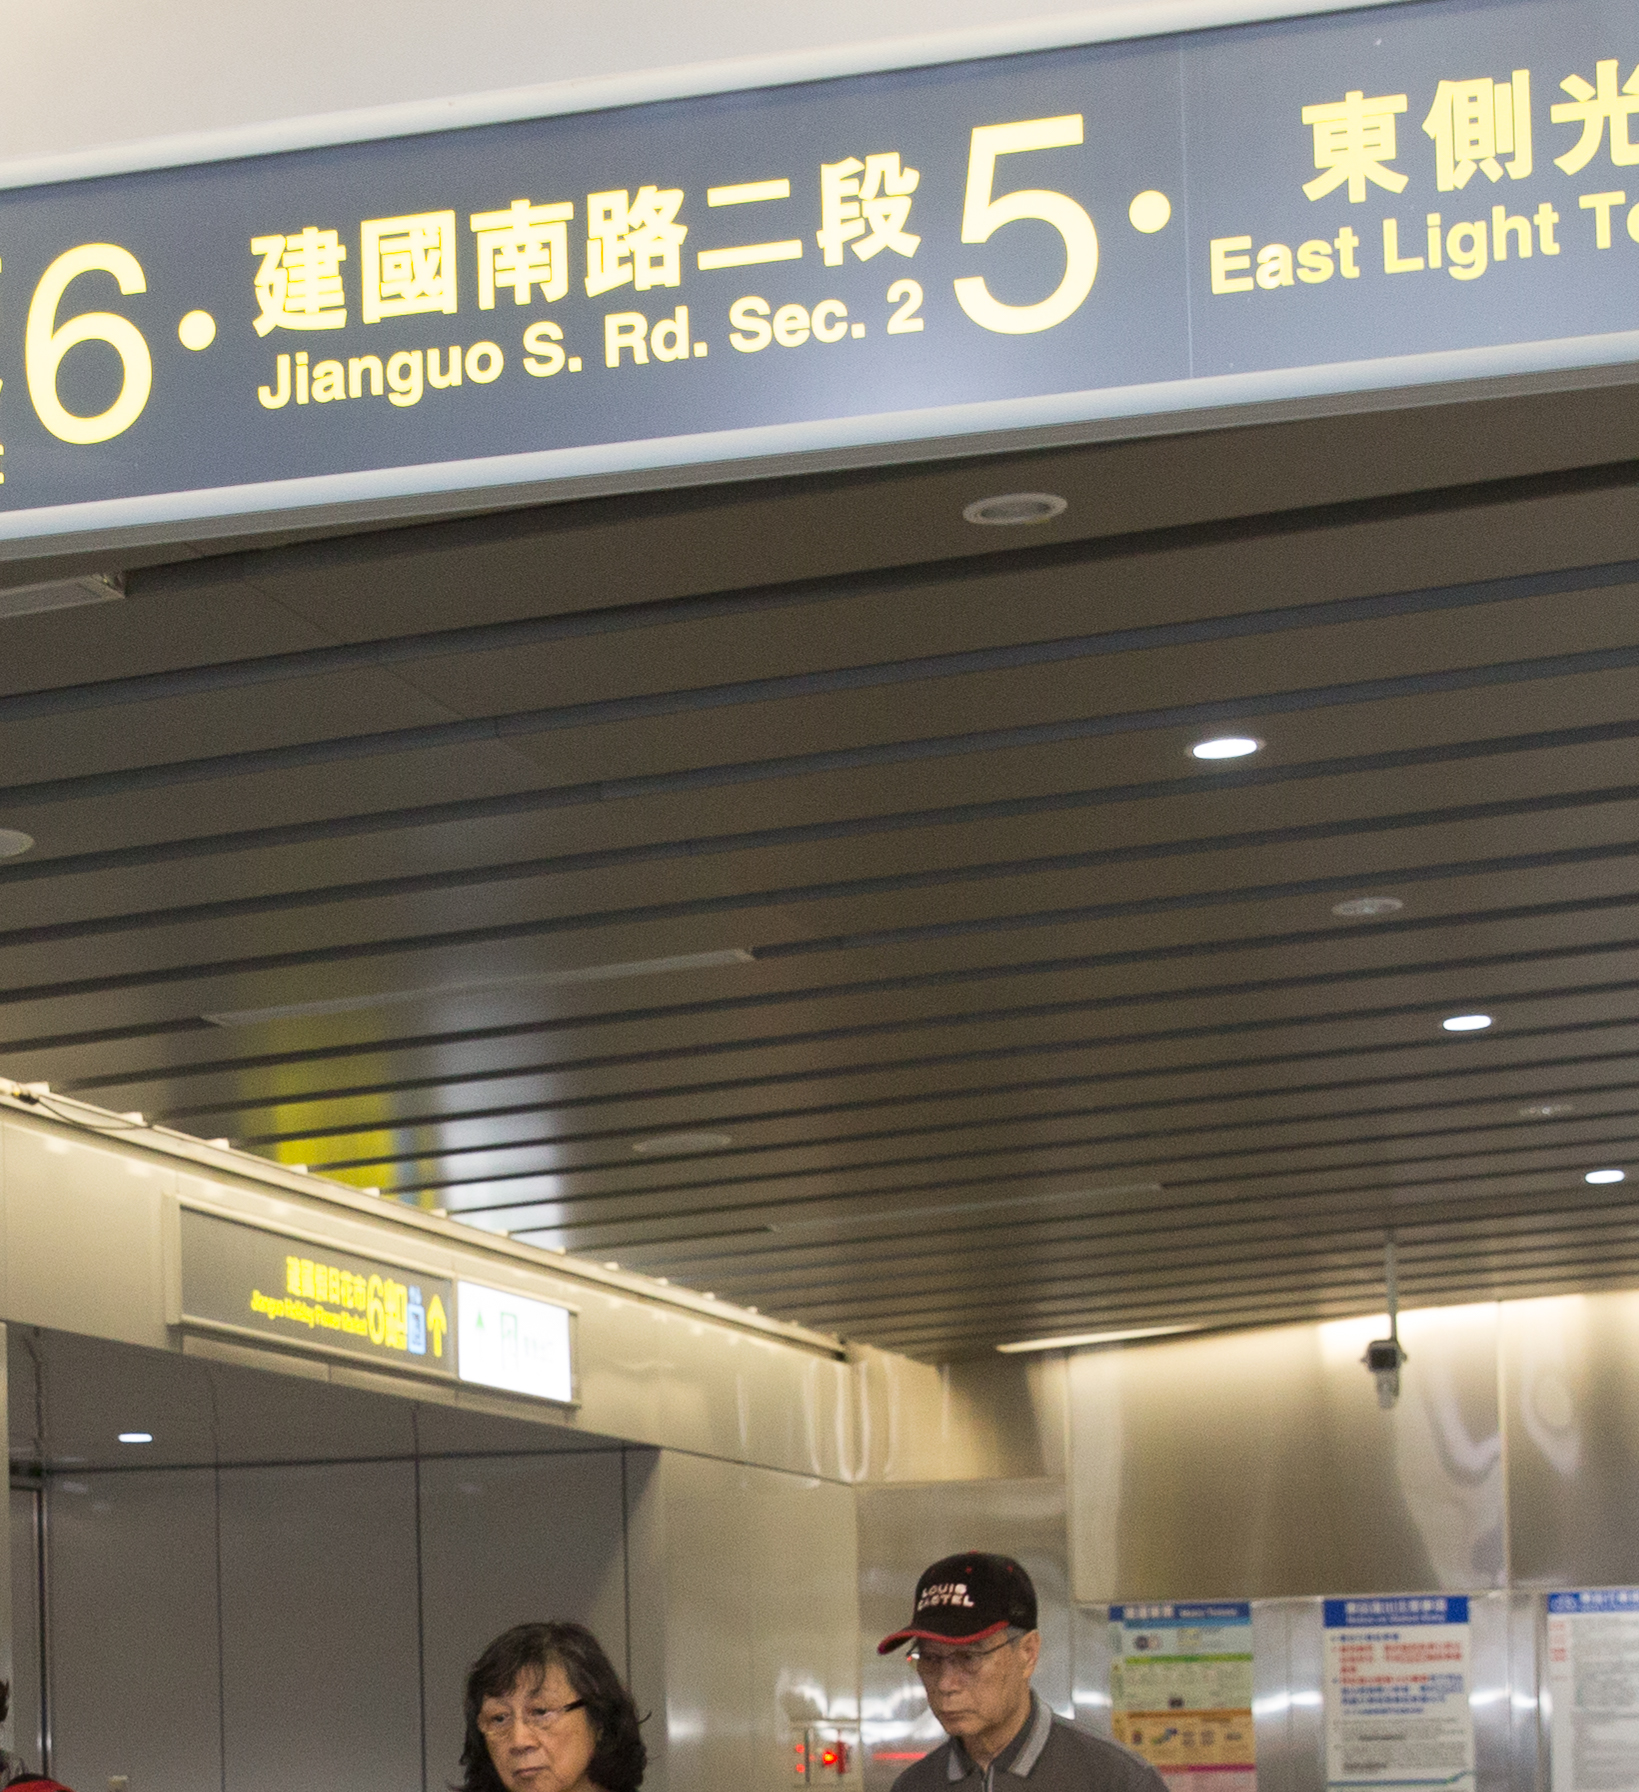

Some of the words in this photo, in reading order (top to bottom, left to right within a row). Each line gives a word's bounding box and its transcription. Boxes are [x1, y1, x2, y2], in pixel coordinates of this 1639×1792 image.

[251, 150, 921, 337] 建國南路二段
[952, 114, 1098, 334] 5
[1210, 226, 1360, 296] East
[1381, 199, 1563, 283] Light
[24, 242, 152, 444] 6
[256, 336, 504, 409] Jianguo
[523, 319, 582, 376] S.
[604, 305, 709, 368] Rd.
[728, 292, 867, 350] Sec.
[886, 279, 924, 333] 2
[367, 1273, 386, 1345] 6
[922, 1583, 967, 1598] LOUIS
